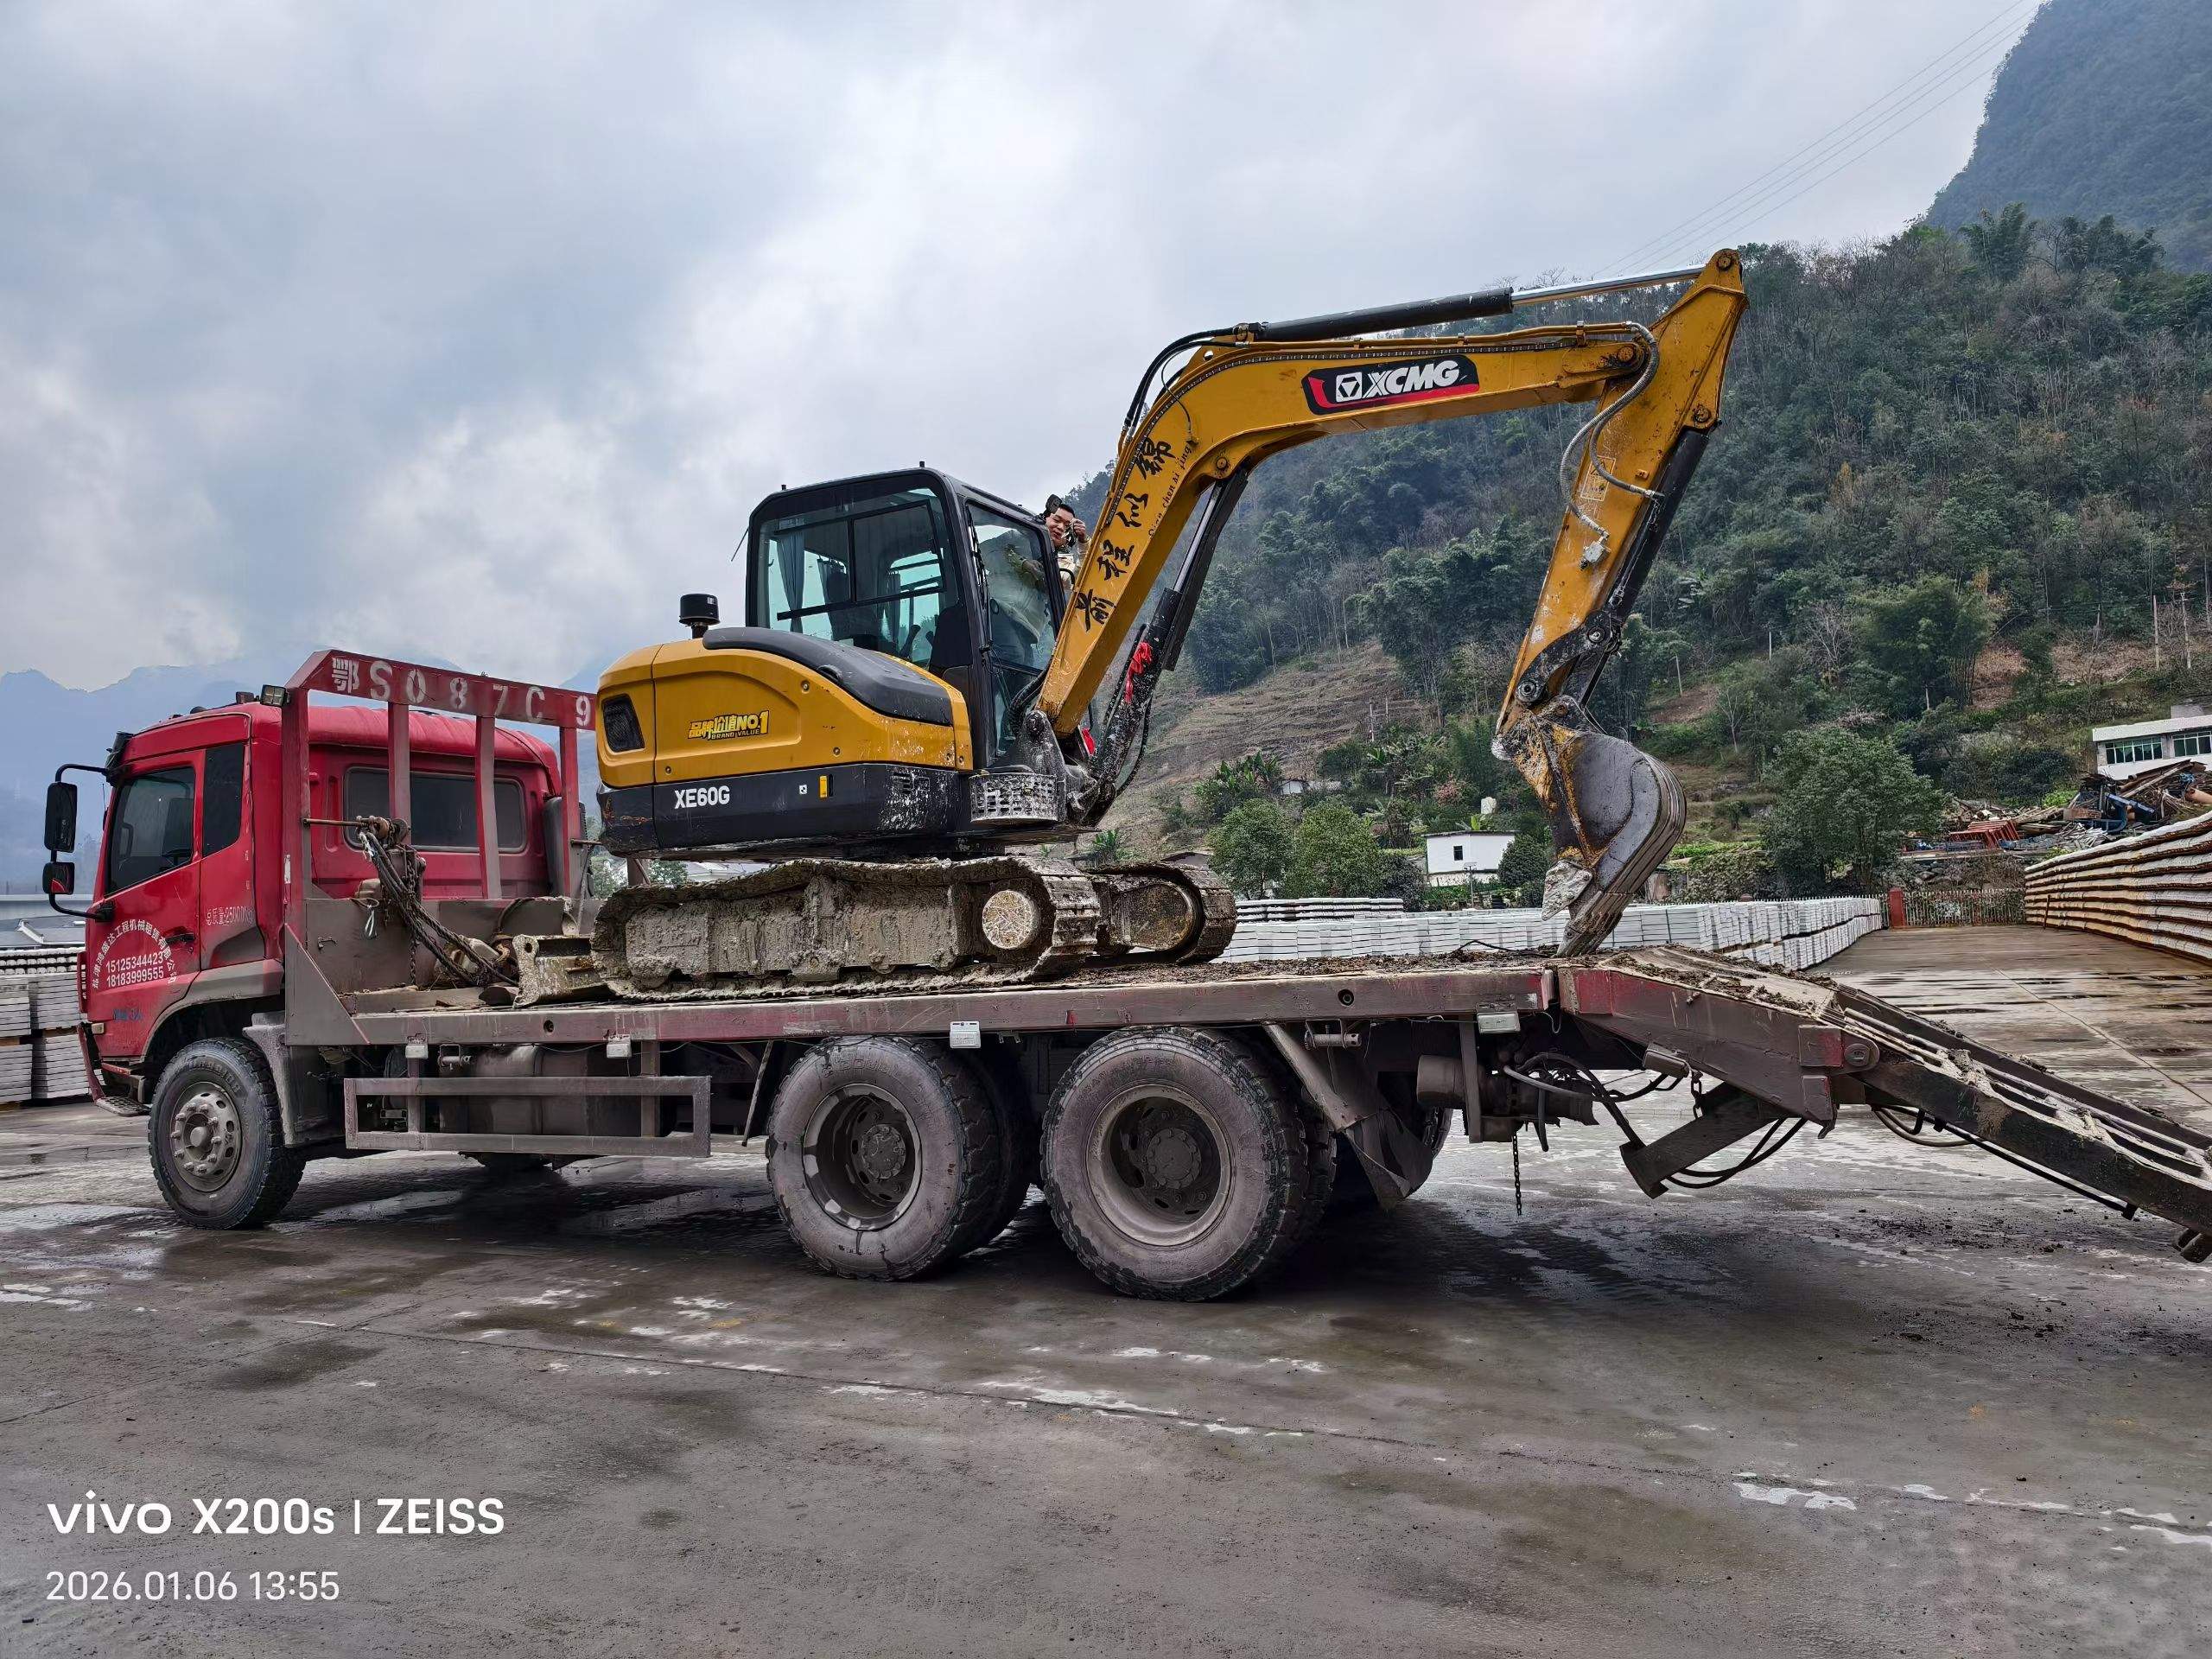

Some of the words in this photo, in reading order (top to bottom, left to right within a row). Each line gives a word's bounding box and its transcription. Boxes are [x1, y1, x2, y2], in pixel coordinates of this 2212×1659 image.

[1363, 359, 1460, 398] XCMG
[711, 731, 735, 740] BRAND
[737, 728, 760, 737] VALUE
[674, 785, 730, 810] XE60G
[105, 950, 164, 974] 15125344423
[106, 966, 164, 988] 18183999555
